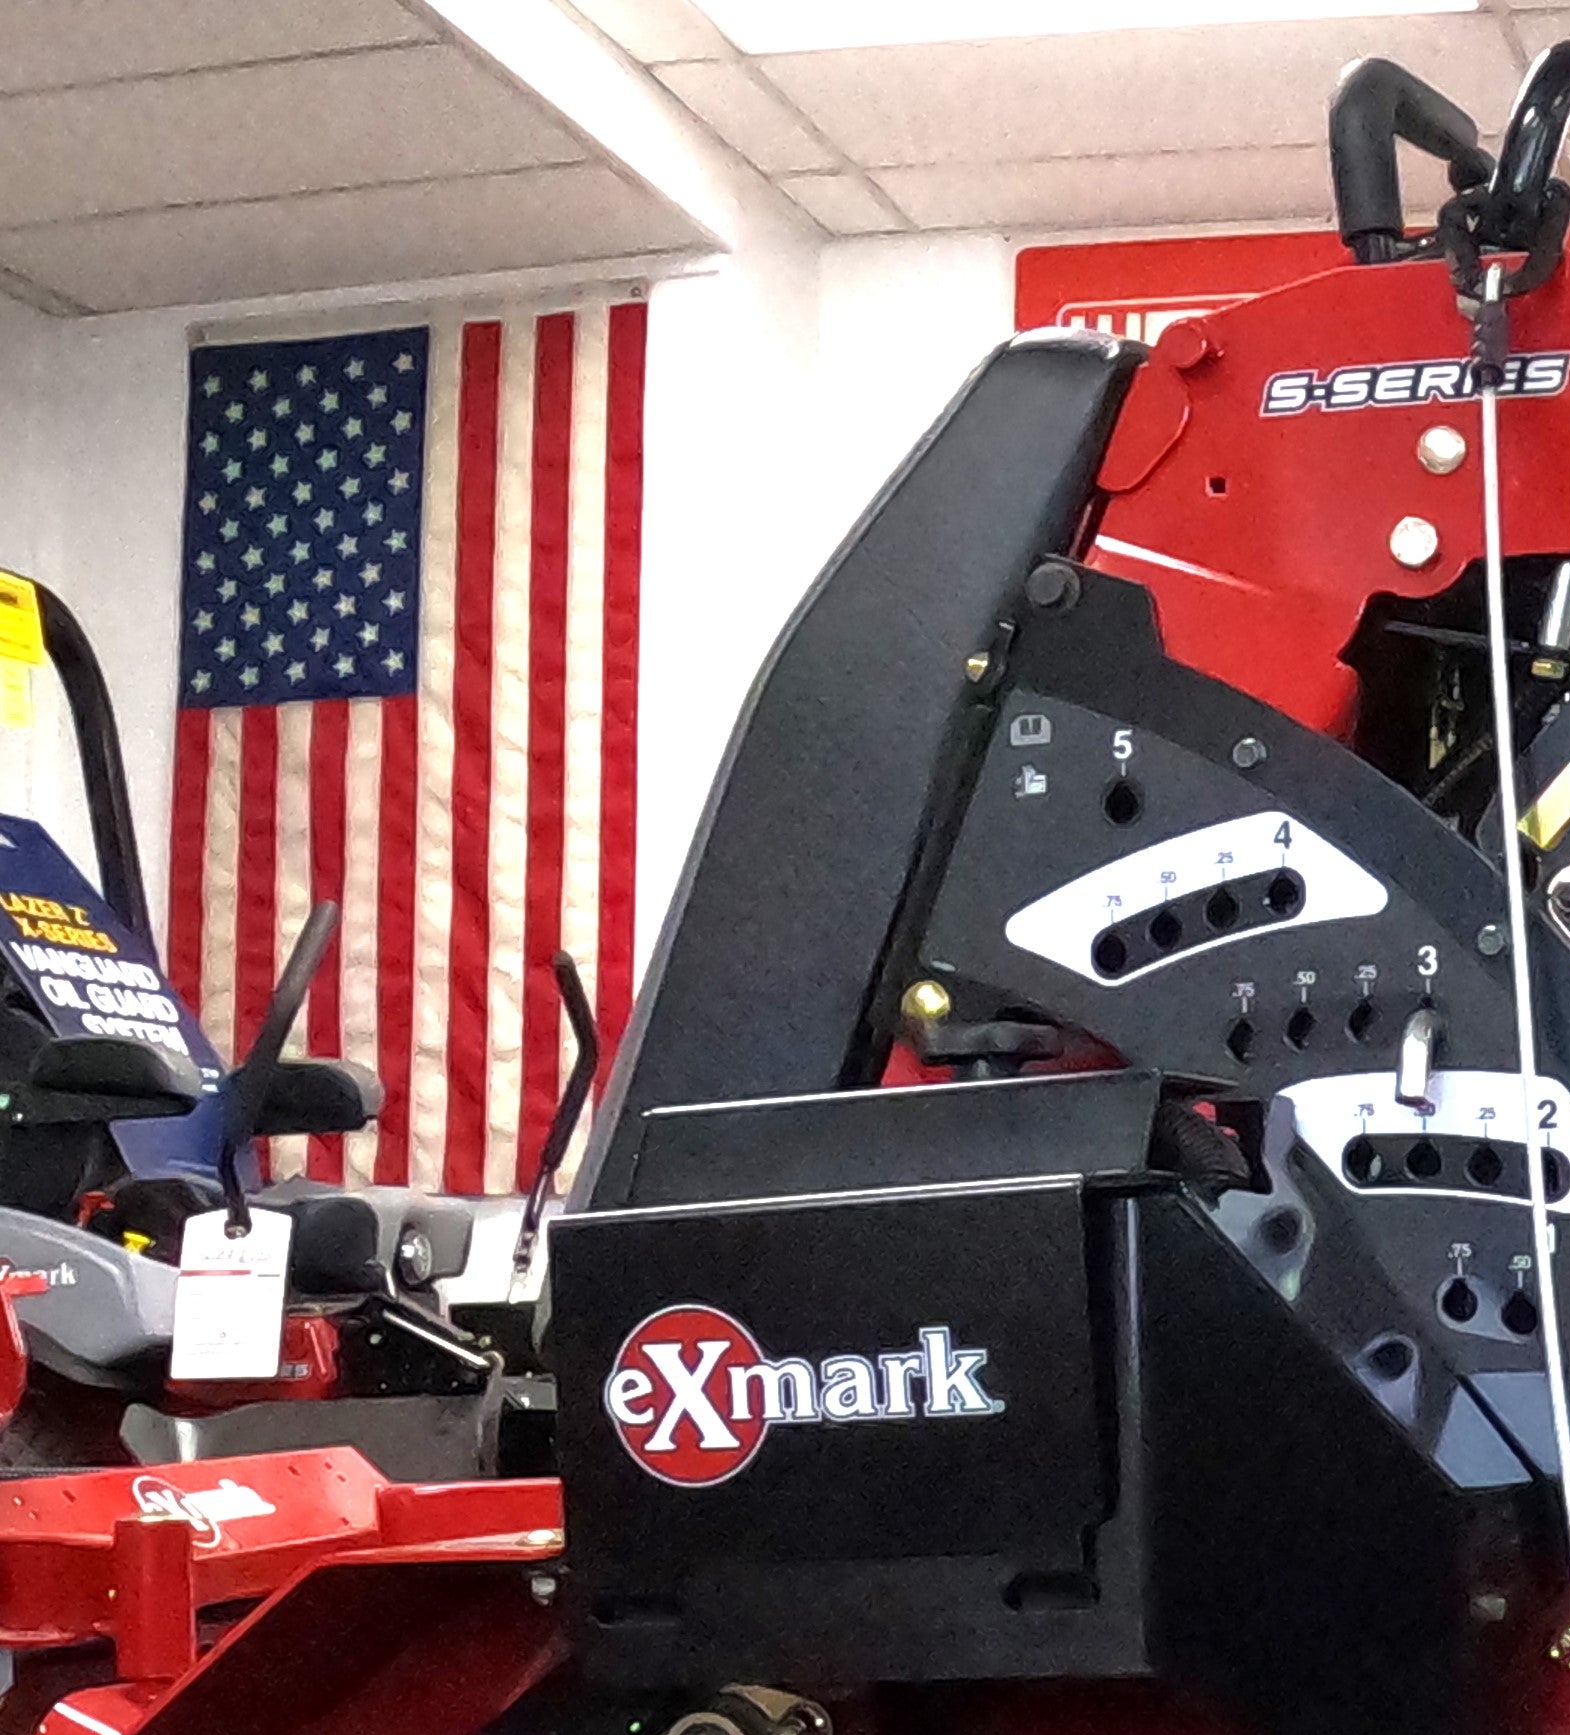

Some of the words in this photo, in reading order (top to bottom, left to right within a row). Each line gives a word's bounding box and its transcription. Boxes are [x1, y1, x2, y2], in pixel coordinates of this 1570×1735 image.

[1112, 729, 1133, 760] 5
[1273, 820, 1292, 850] 4
[9, 940, 161, 991] VANGUARD
[1293, 970, 1316, 985] .50
[1354, 964, 1377, 979] .25
[1417, 945, 1438, 976] 3
[39, 975, 91, 1010] OIL
[86, 983, 180, 1023] GUARD
[1475, 1106, 1497, 1120] .25
[1537, 1099, 1558, 1129] 2
[1447, 1242, 1472, 1258] .75
[1508, 1255, 1532, 1270] .50
[605, 1326, 997, 1453] eXmark
